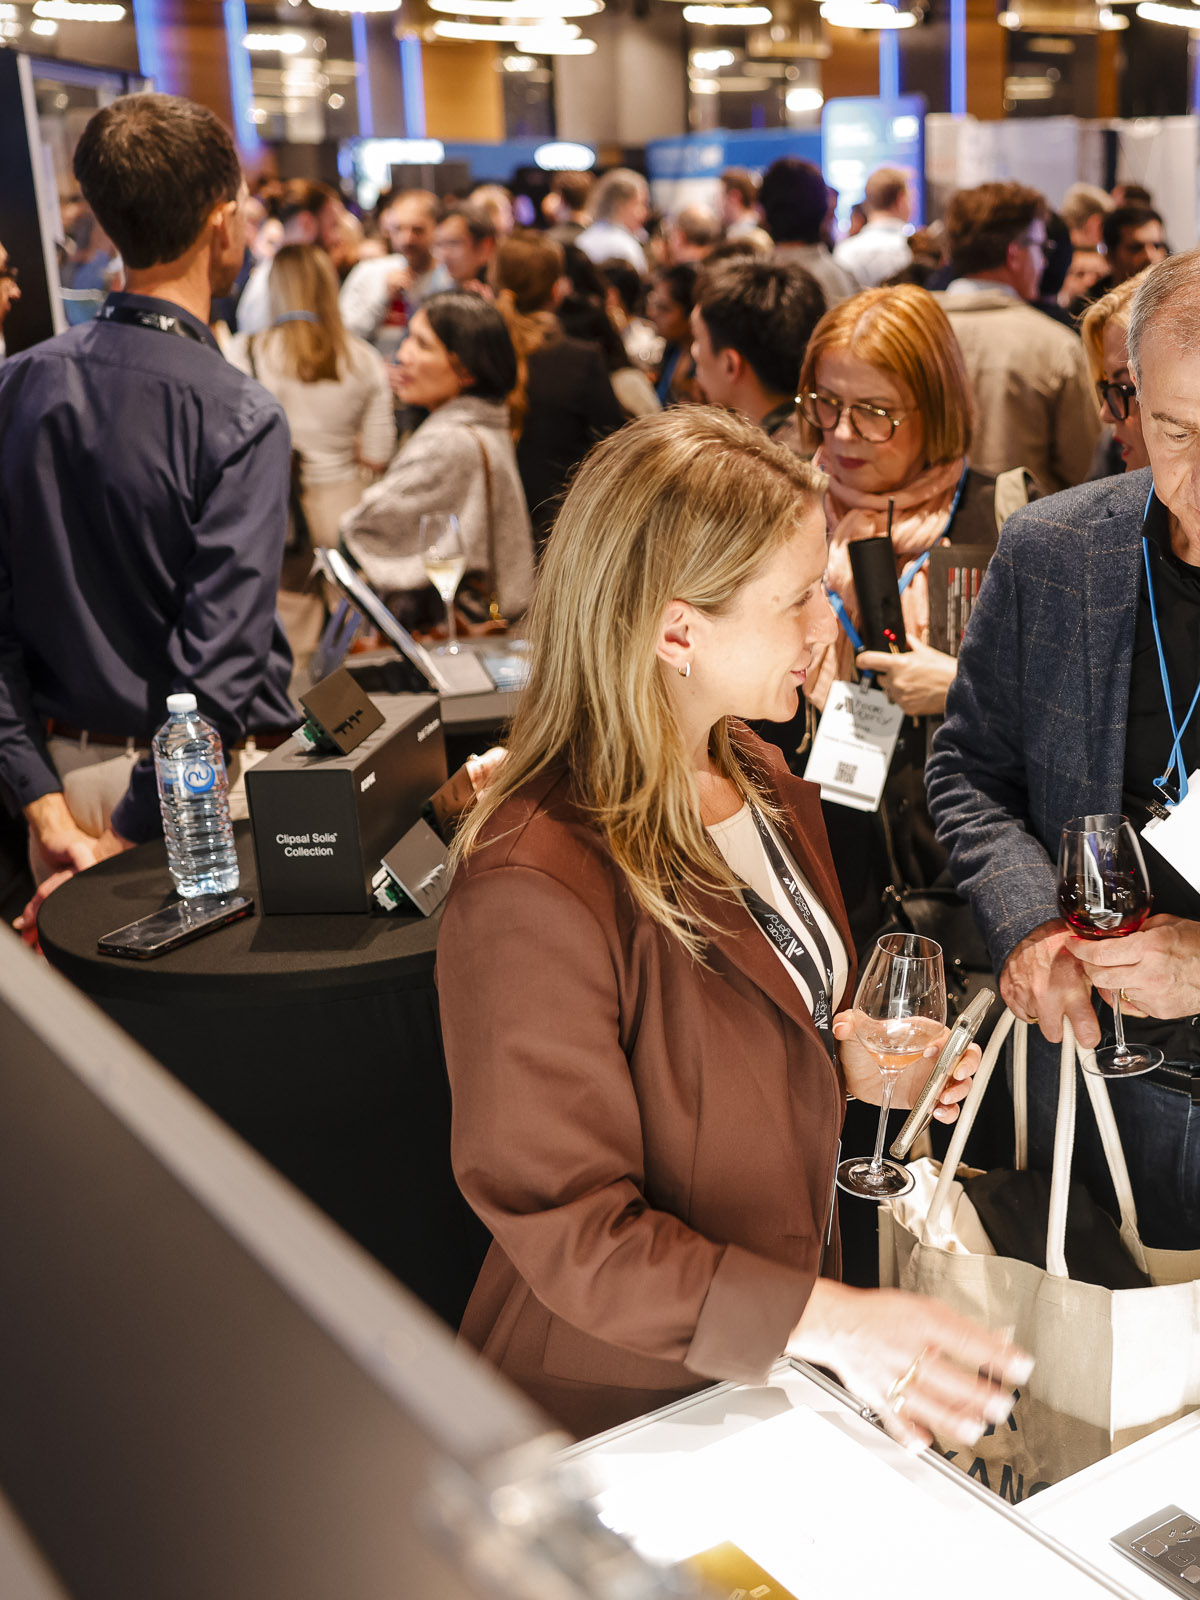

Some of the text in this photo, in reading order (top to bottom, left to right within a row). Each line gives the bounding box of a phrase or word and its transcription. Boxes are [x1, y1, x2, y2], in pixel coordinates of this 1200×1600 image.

[275, 833, 310, 845] Clipsal
[284, 846, 334, 857] Collection
[763, 914, 793, 939] Agency
